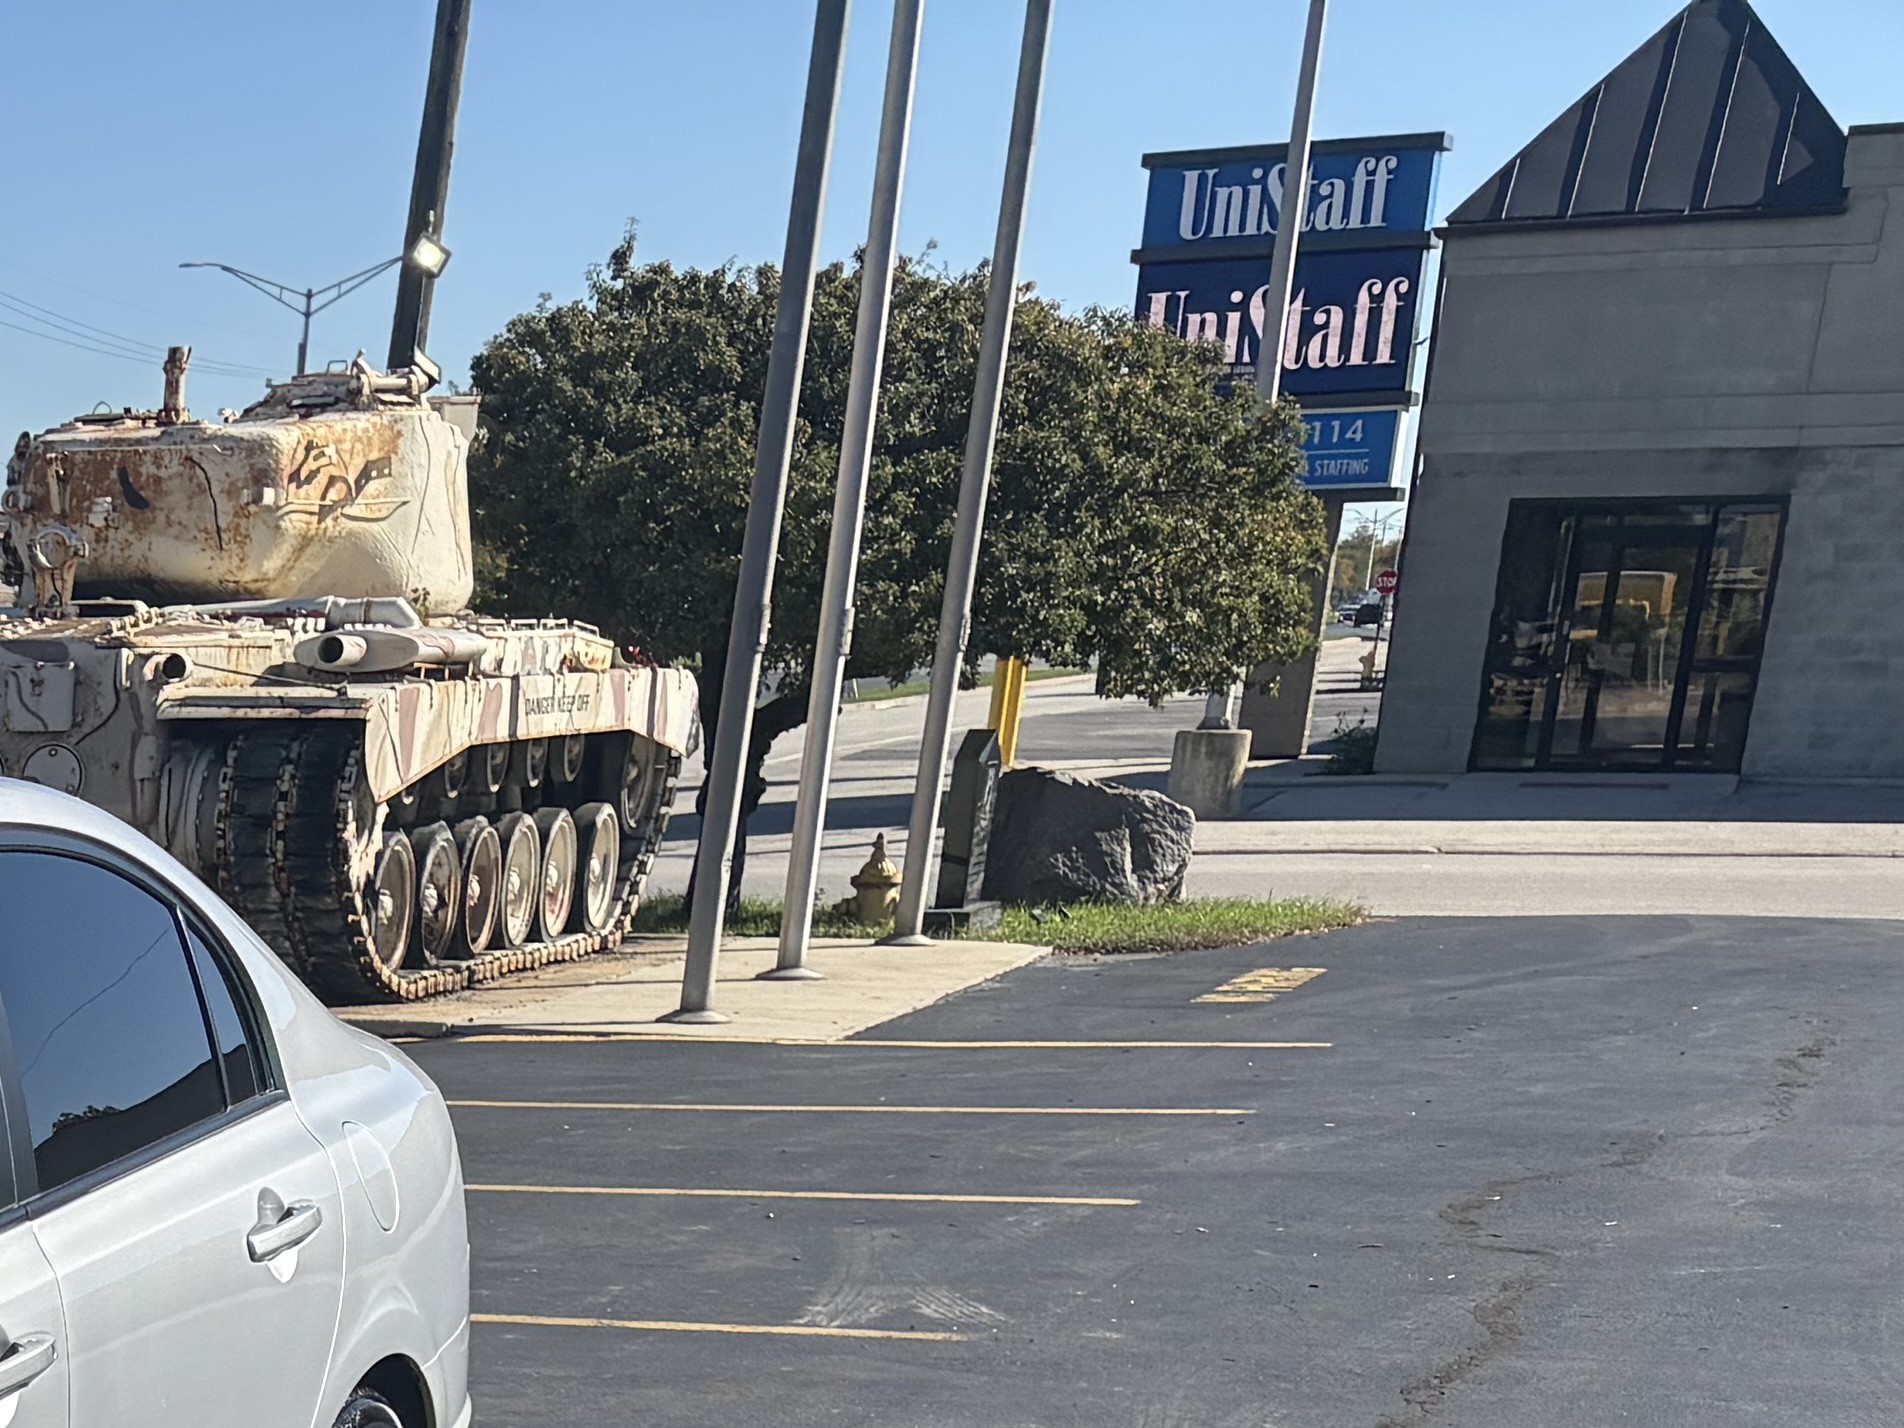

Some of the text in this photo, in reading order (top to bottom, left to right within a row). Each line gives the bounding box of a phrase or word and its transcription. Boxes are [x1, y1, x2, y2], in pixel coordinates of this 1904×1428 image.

[1179, 155, 1398, 240] UniStaff
[1148, 277, 1409, 370] UniStaff
[1314, 459, 1369, 477] STAFFING
